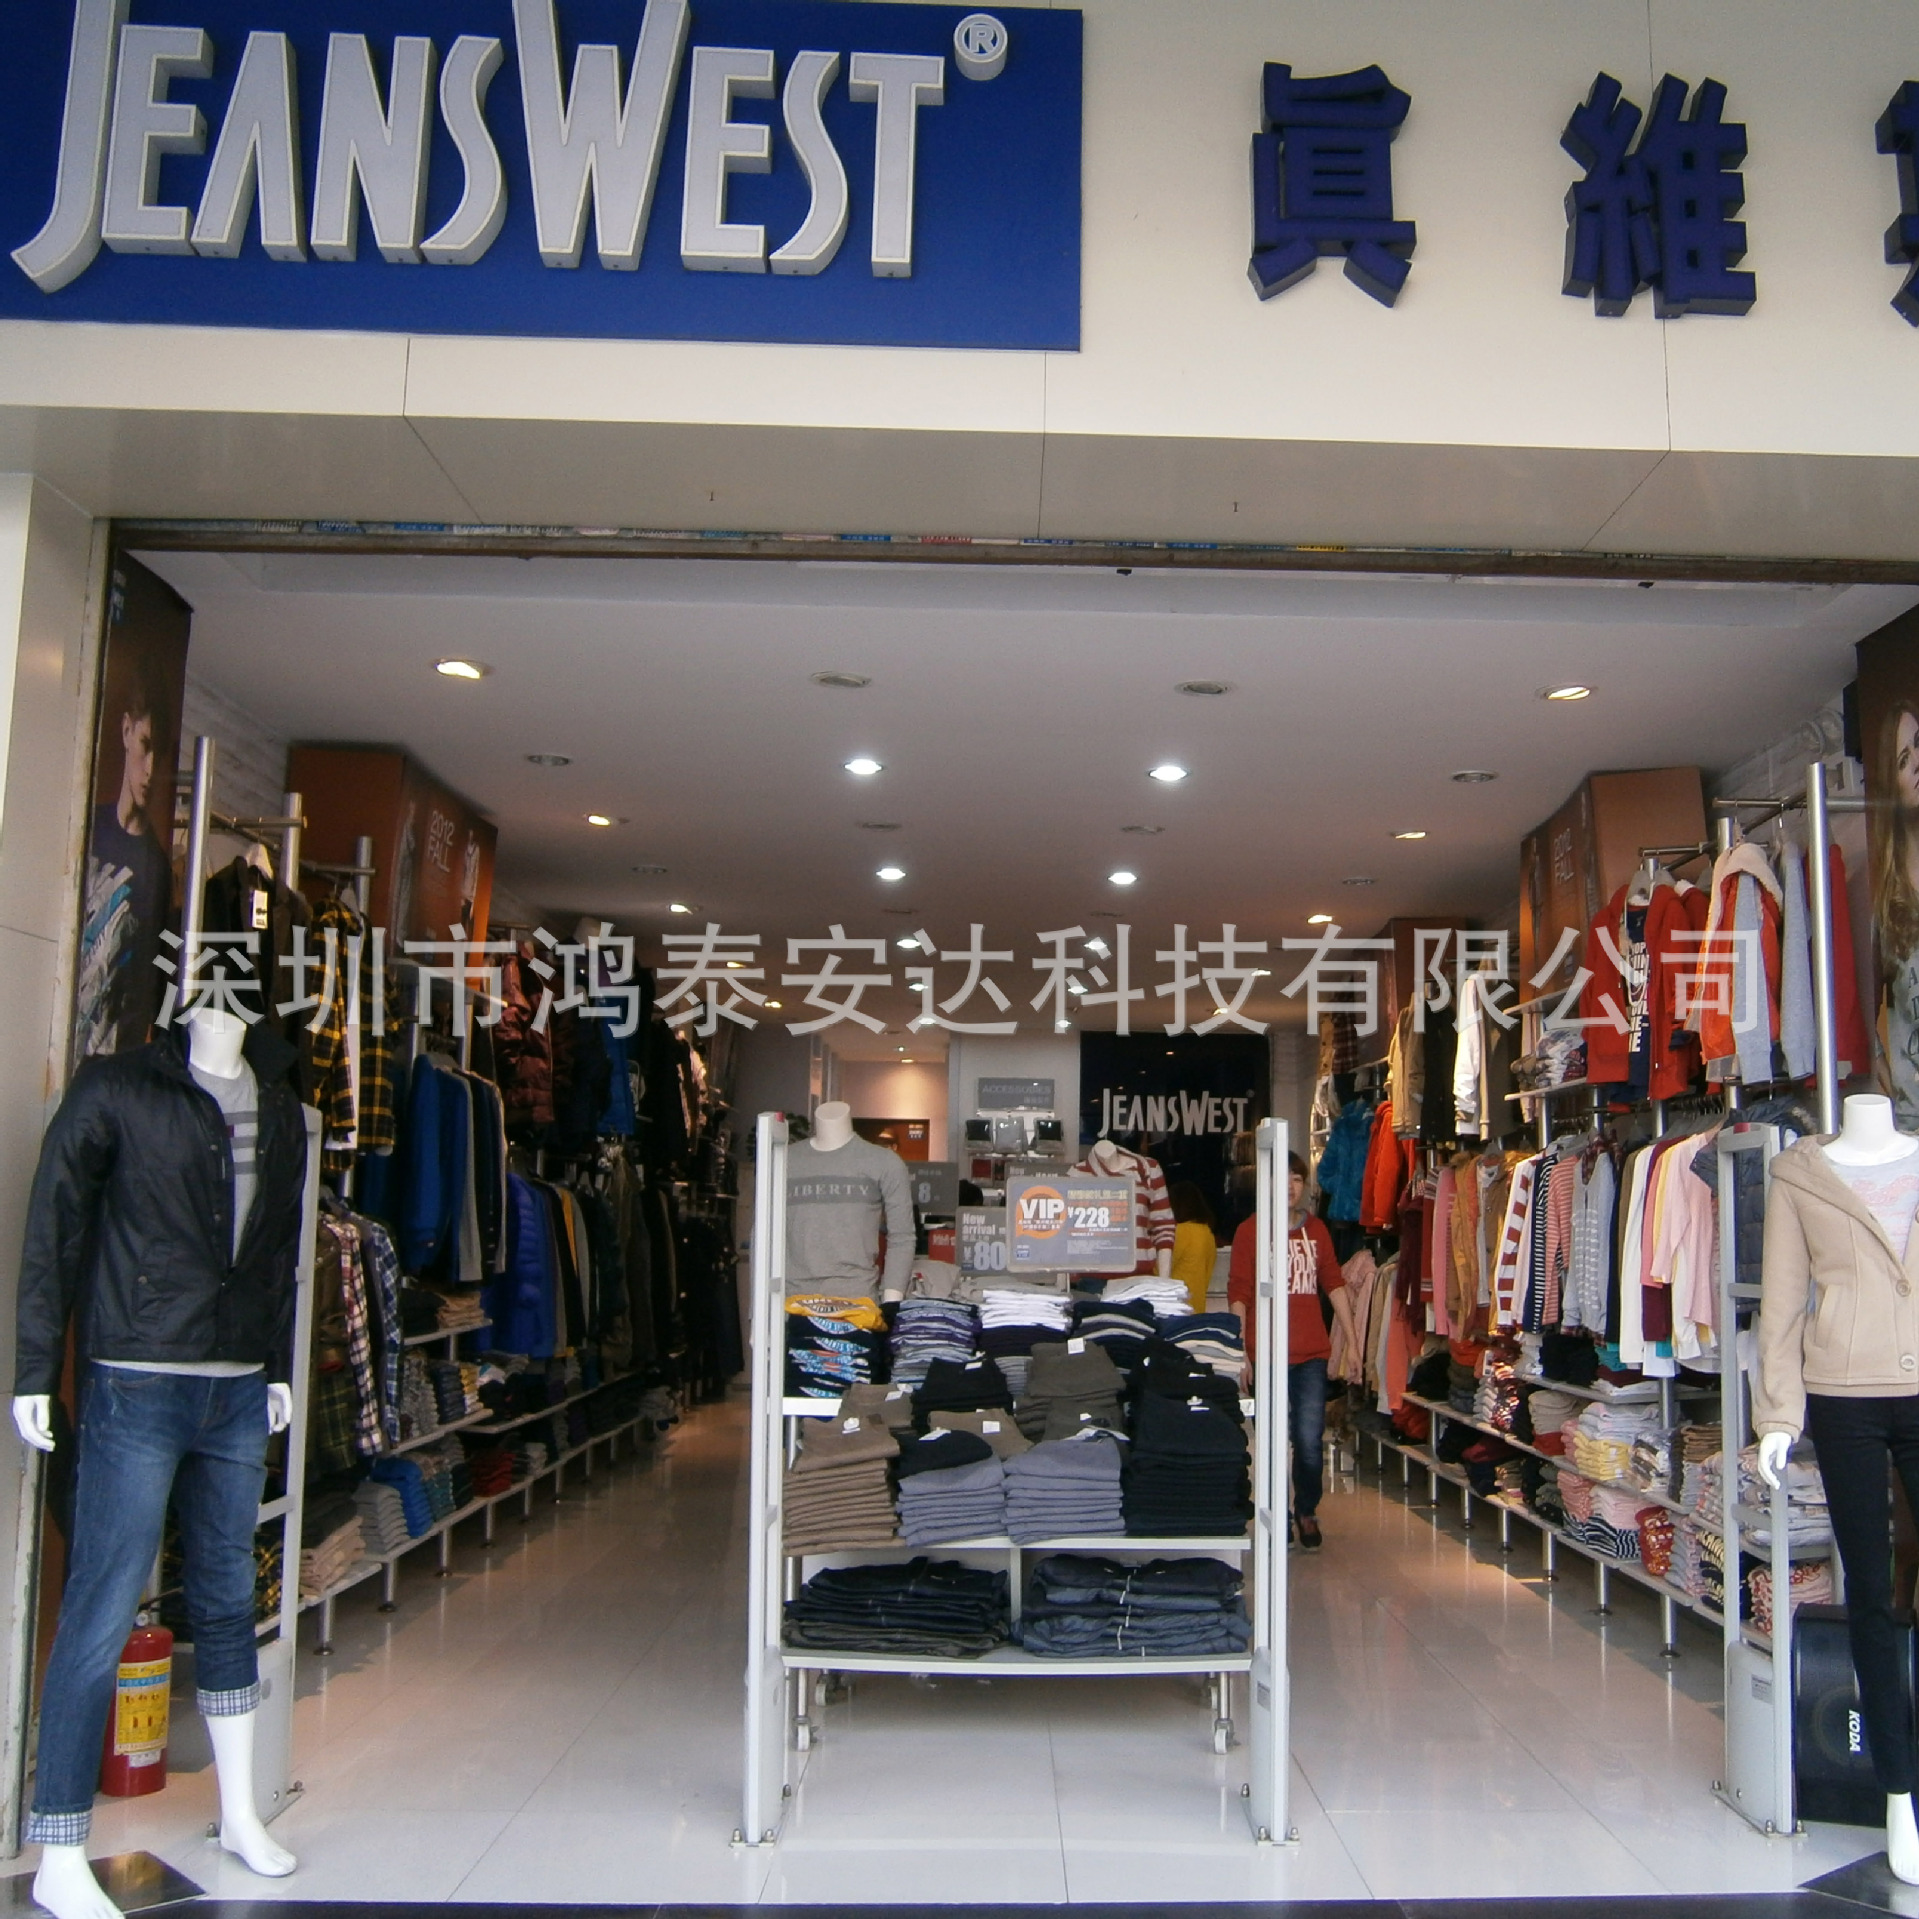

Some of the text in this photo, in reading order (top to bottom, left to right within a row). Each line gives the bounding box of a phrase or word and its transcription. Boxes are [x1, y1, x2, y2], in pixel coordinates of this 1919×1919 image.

[430, 810, 455, 847] 2012
[427, 834, 450, 873] FALL
[1098, 1087, 1249, 1138] JEANSWEST
[962, 1213, 986, 1225] New
[1019, 1198, 1065, 1219] VIP
[962, 1224, 996, 1236] arrival
[1849, 1708, 1861, 1752] KODA
